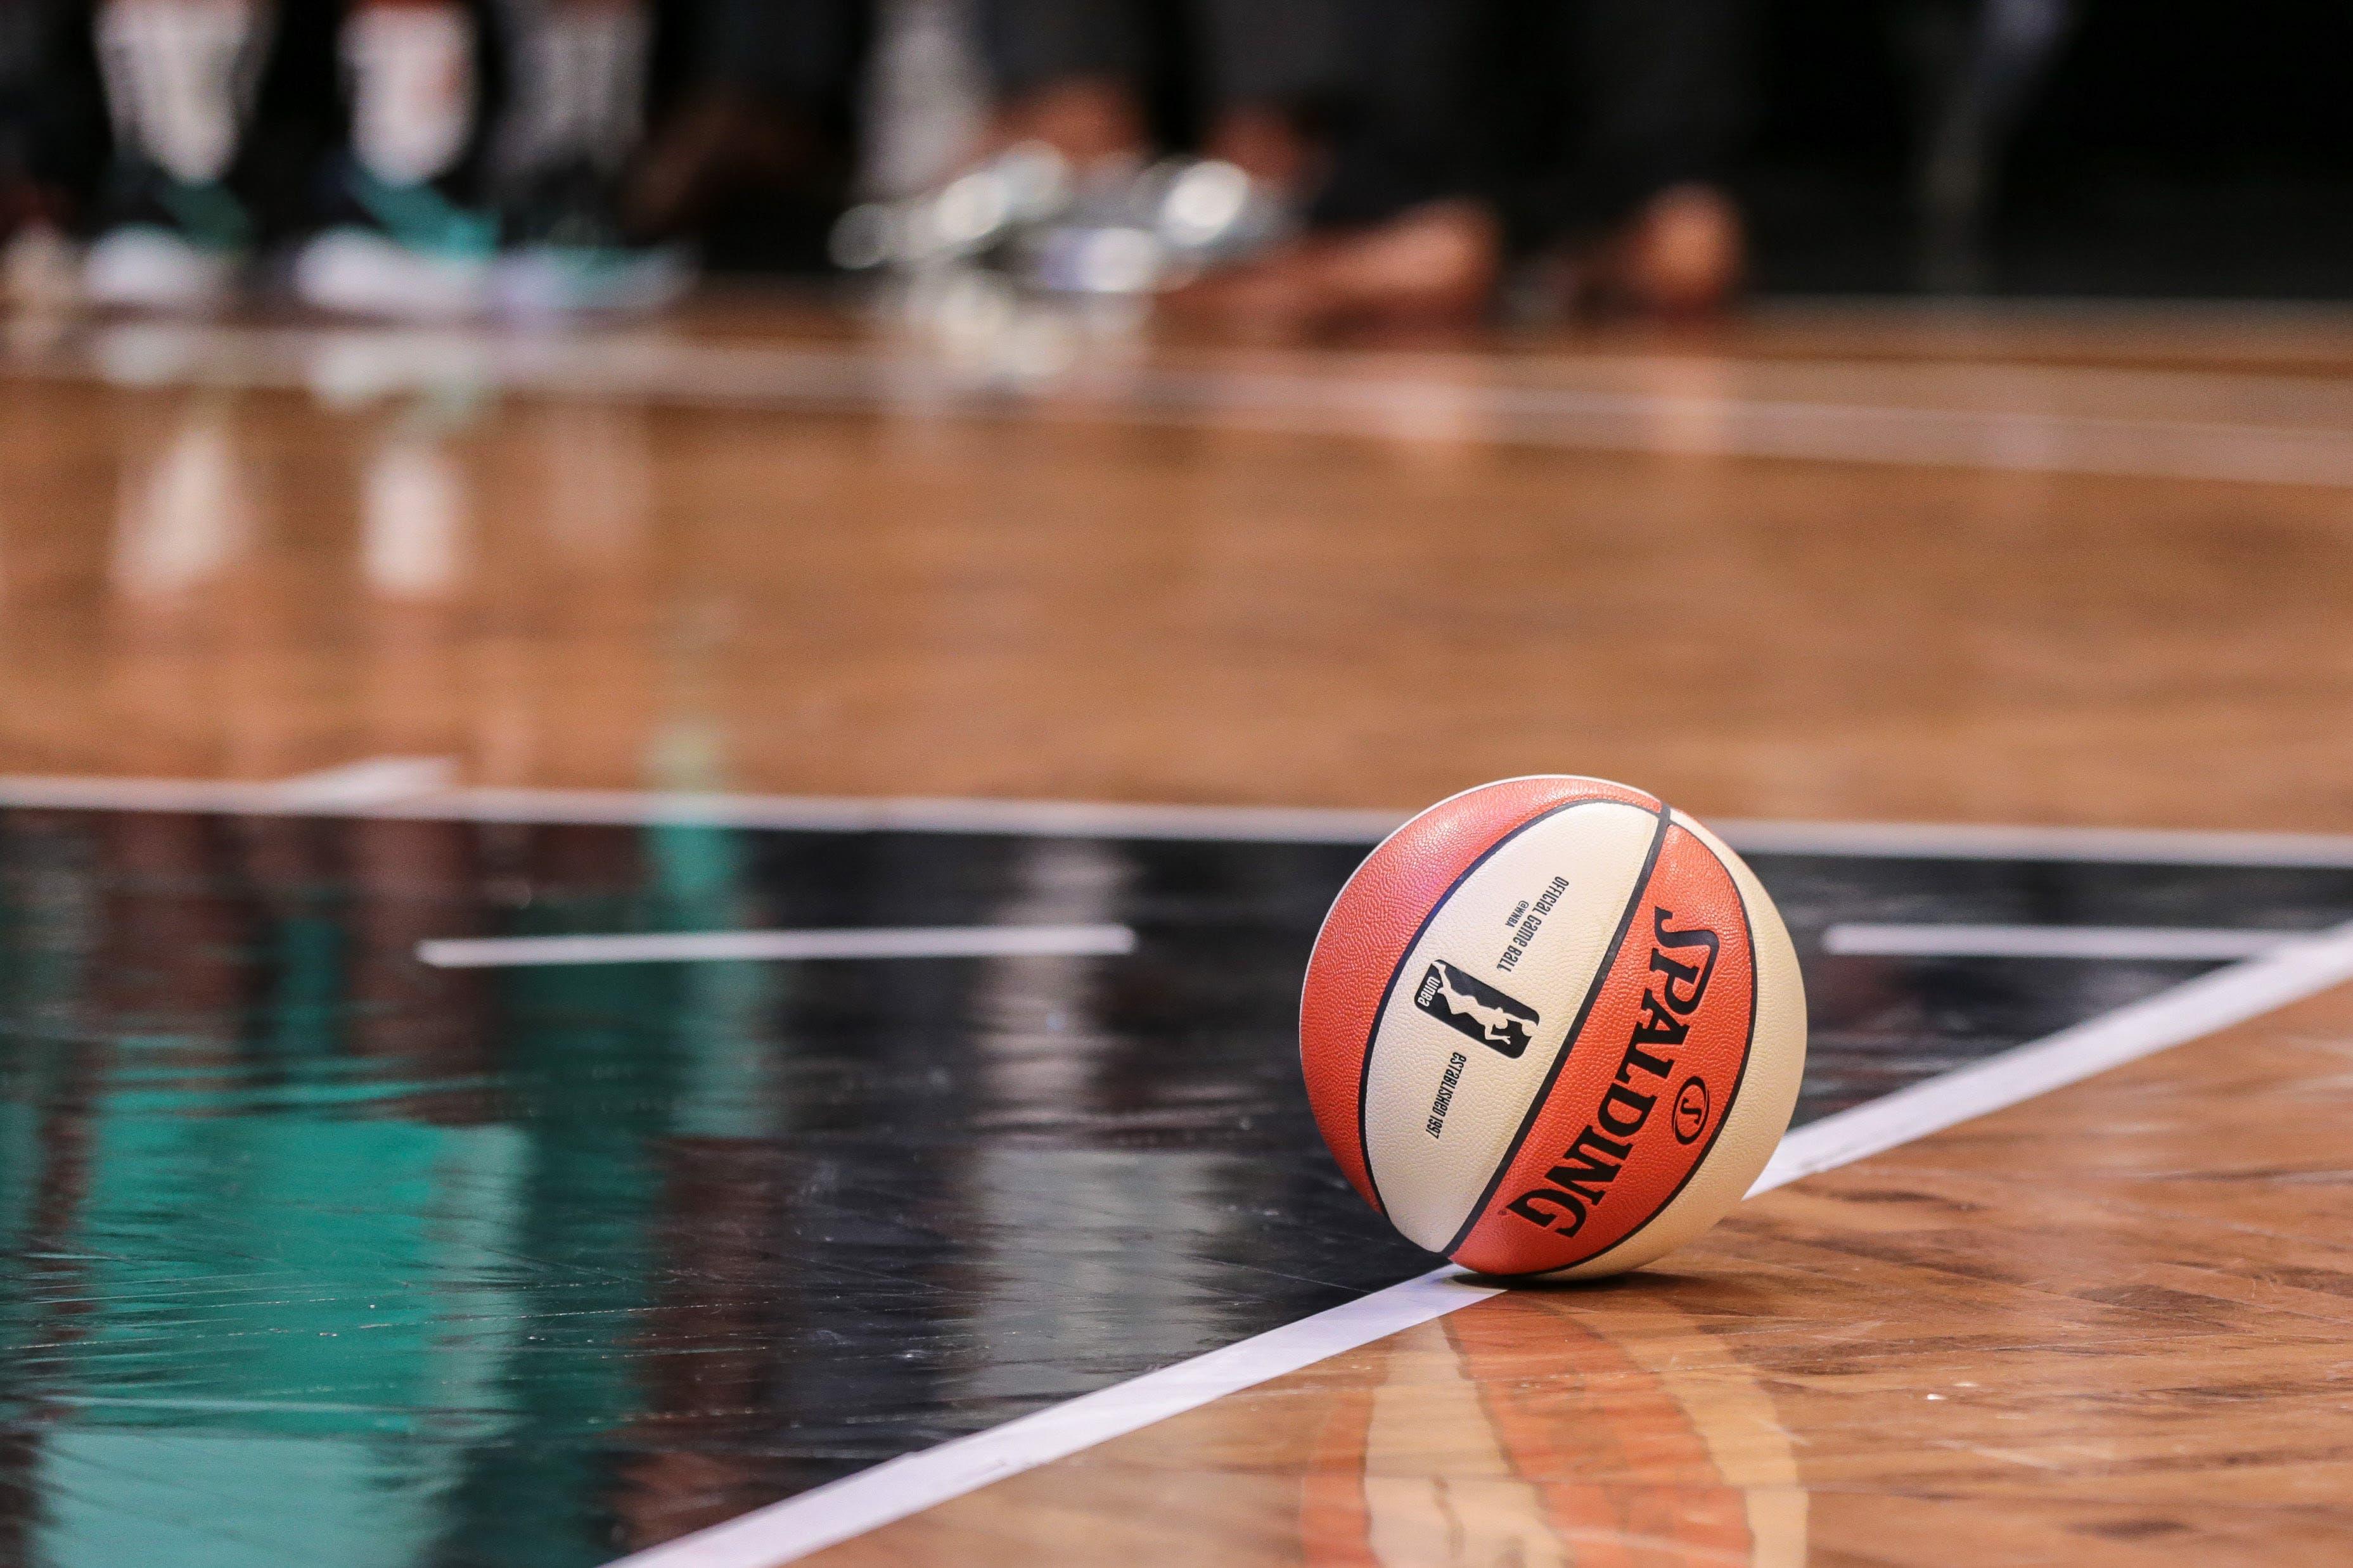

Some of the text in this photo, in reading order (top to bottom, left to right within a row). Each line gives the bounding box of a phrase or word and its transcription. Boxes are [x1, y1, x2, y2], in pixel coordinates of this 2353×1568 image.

[1505, 900, 1529, 927] @WNBA
[1506, 906, 1720, 1238] SPALDING
[1425, 1115, 1444, 1139] 1997
